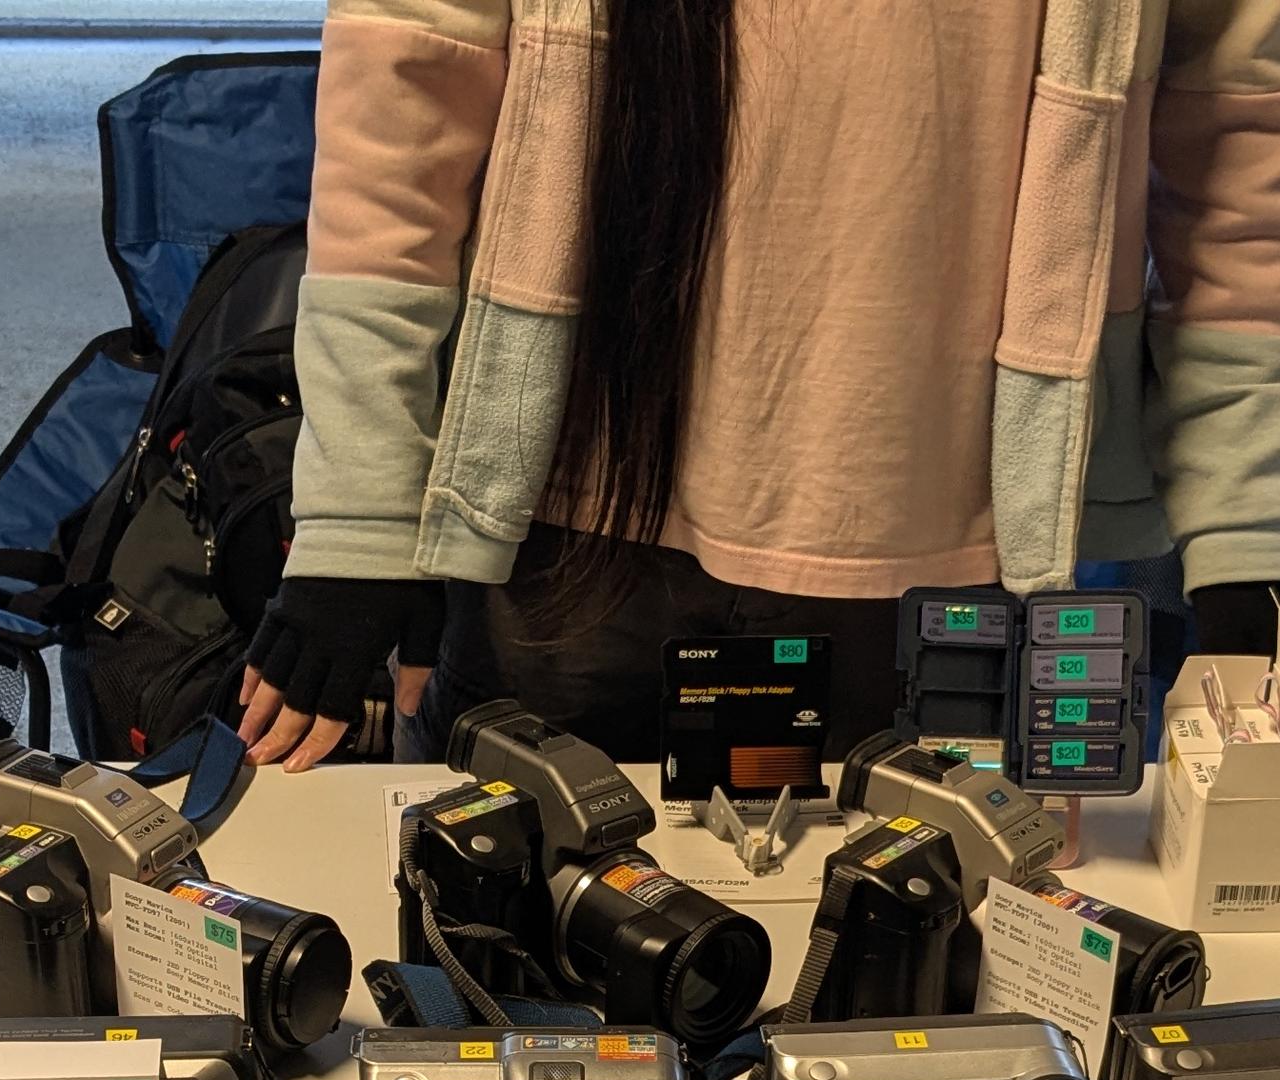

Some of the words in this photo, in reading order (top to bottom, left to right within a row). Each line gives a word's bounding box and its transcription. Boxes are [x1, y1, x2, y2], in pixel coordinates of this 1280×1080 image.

[952, 612, 974, 624] $35
[1064, 615, 1088, 628] $20
[679, 649, 718, 659] SONY
[779, 645, 803, 657] $80
[1059, 661, 1083, 674] $20
[707, 687, 724, 695] Stick
[729, 687, 751, 695] Floppy
[752, 687, 767, 695] Disk
[767, 687, 795, 695] Adapter
[1058, 704, 1082, 716] $20
[1056, 747, 1080, 759] $20
[589, 792, 631, 814] SONY
[131, 812, 170, 841] SONY
[211, 923, 234, 944] $75
[1084, 933, 1109, 956] $75
